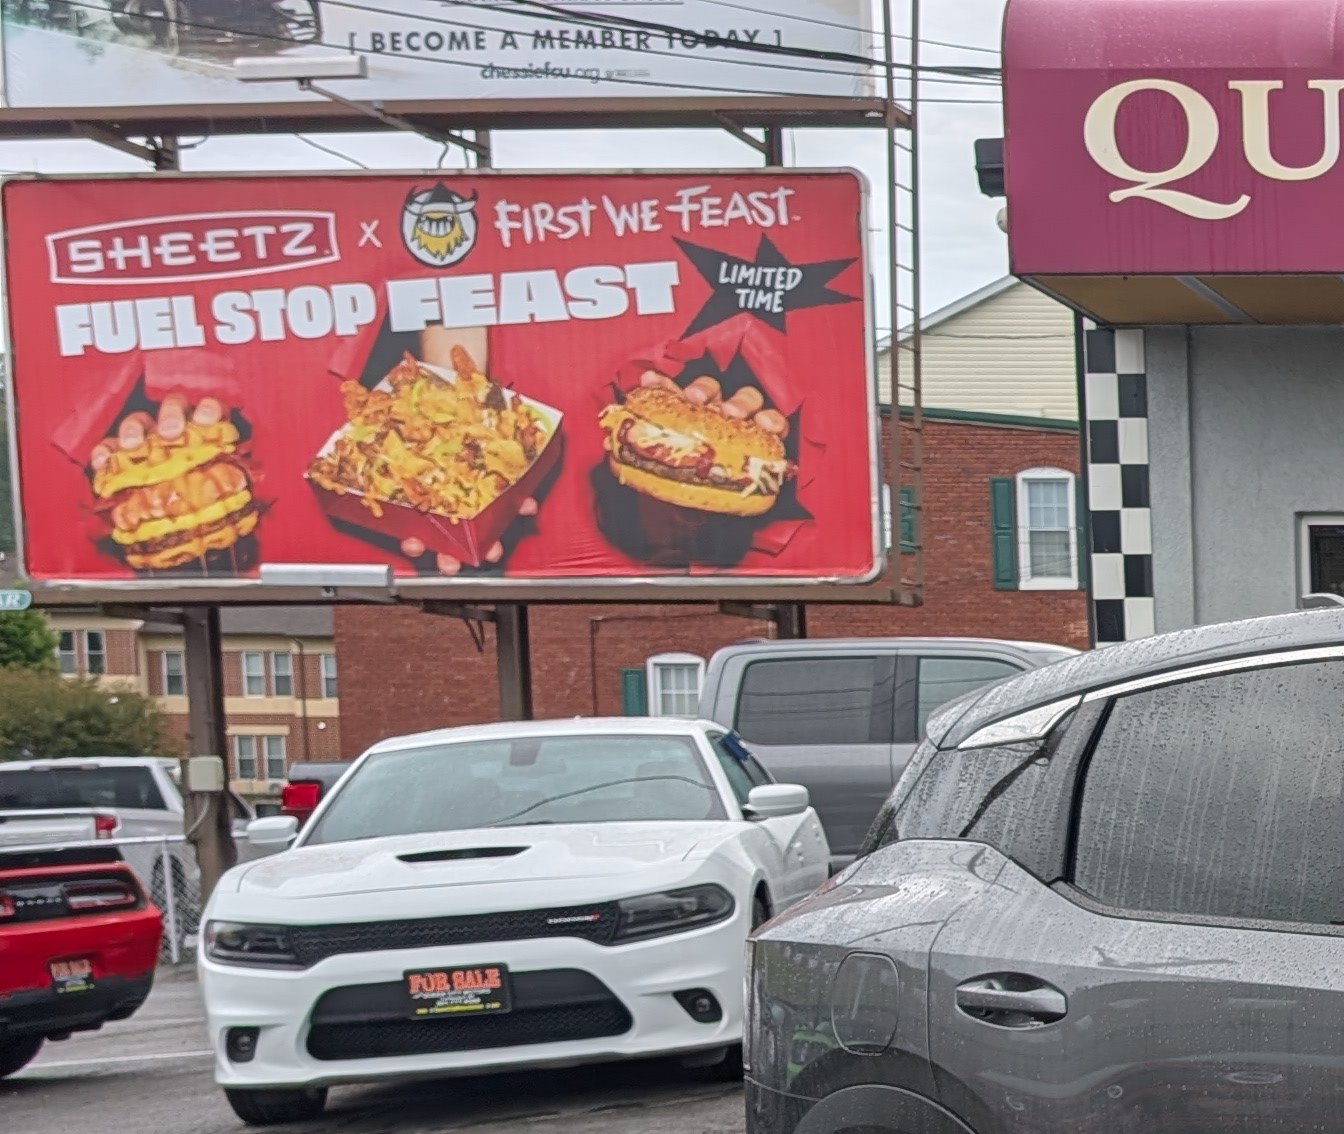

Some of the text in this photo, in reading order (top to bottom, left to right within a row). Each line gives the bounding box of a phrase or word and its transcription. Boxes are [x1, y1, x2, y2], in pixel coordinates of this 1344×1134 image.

[370, 30, 487, 52] BECOME
[499, 30, 520, 50] A
[532, 28, 652, 50] MEMBER
[66, 221, 317, 274] SHEETZ
[493, 197, 598, 248] FIRST
[601, 193, 664, 239] WE
[664, 184, 796, 233] FEAST
[718, 260, 803, 292] LIMITED
[55, 260, 681, 358] FUEL STOP FEAST
[734, 287, 787, 314] TIME
[408, 971, 451, 995] FOR
[451, 967, 502, 991] SALE
